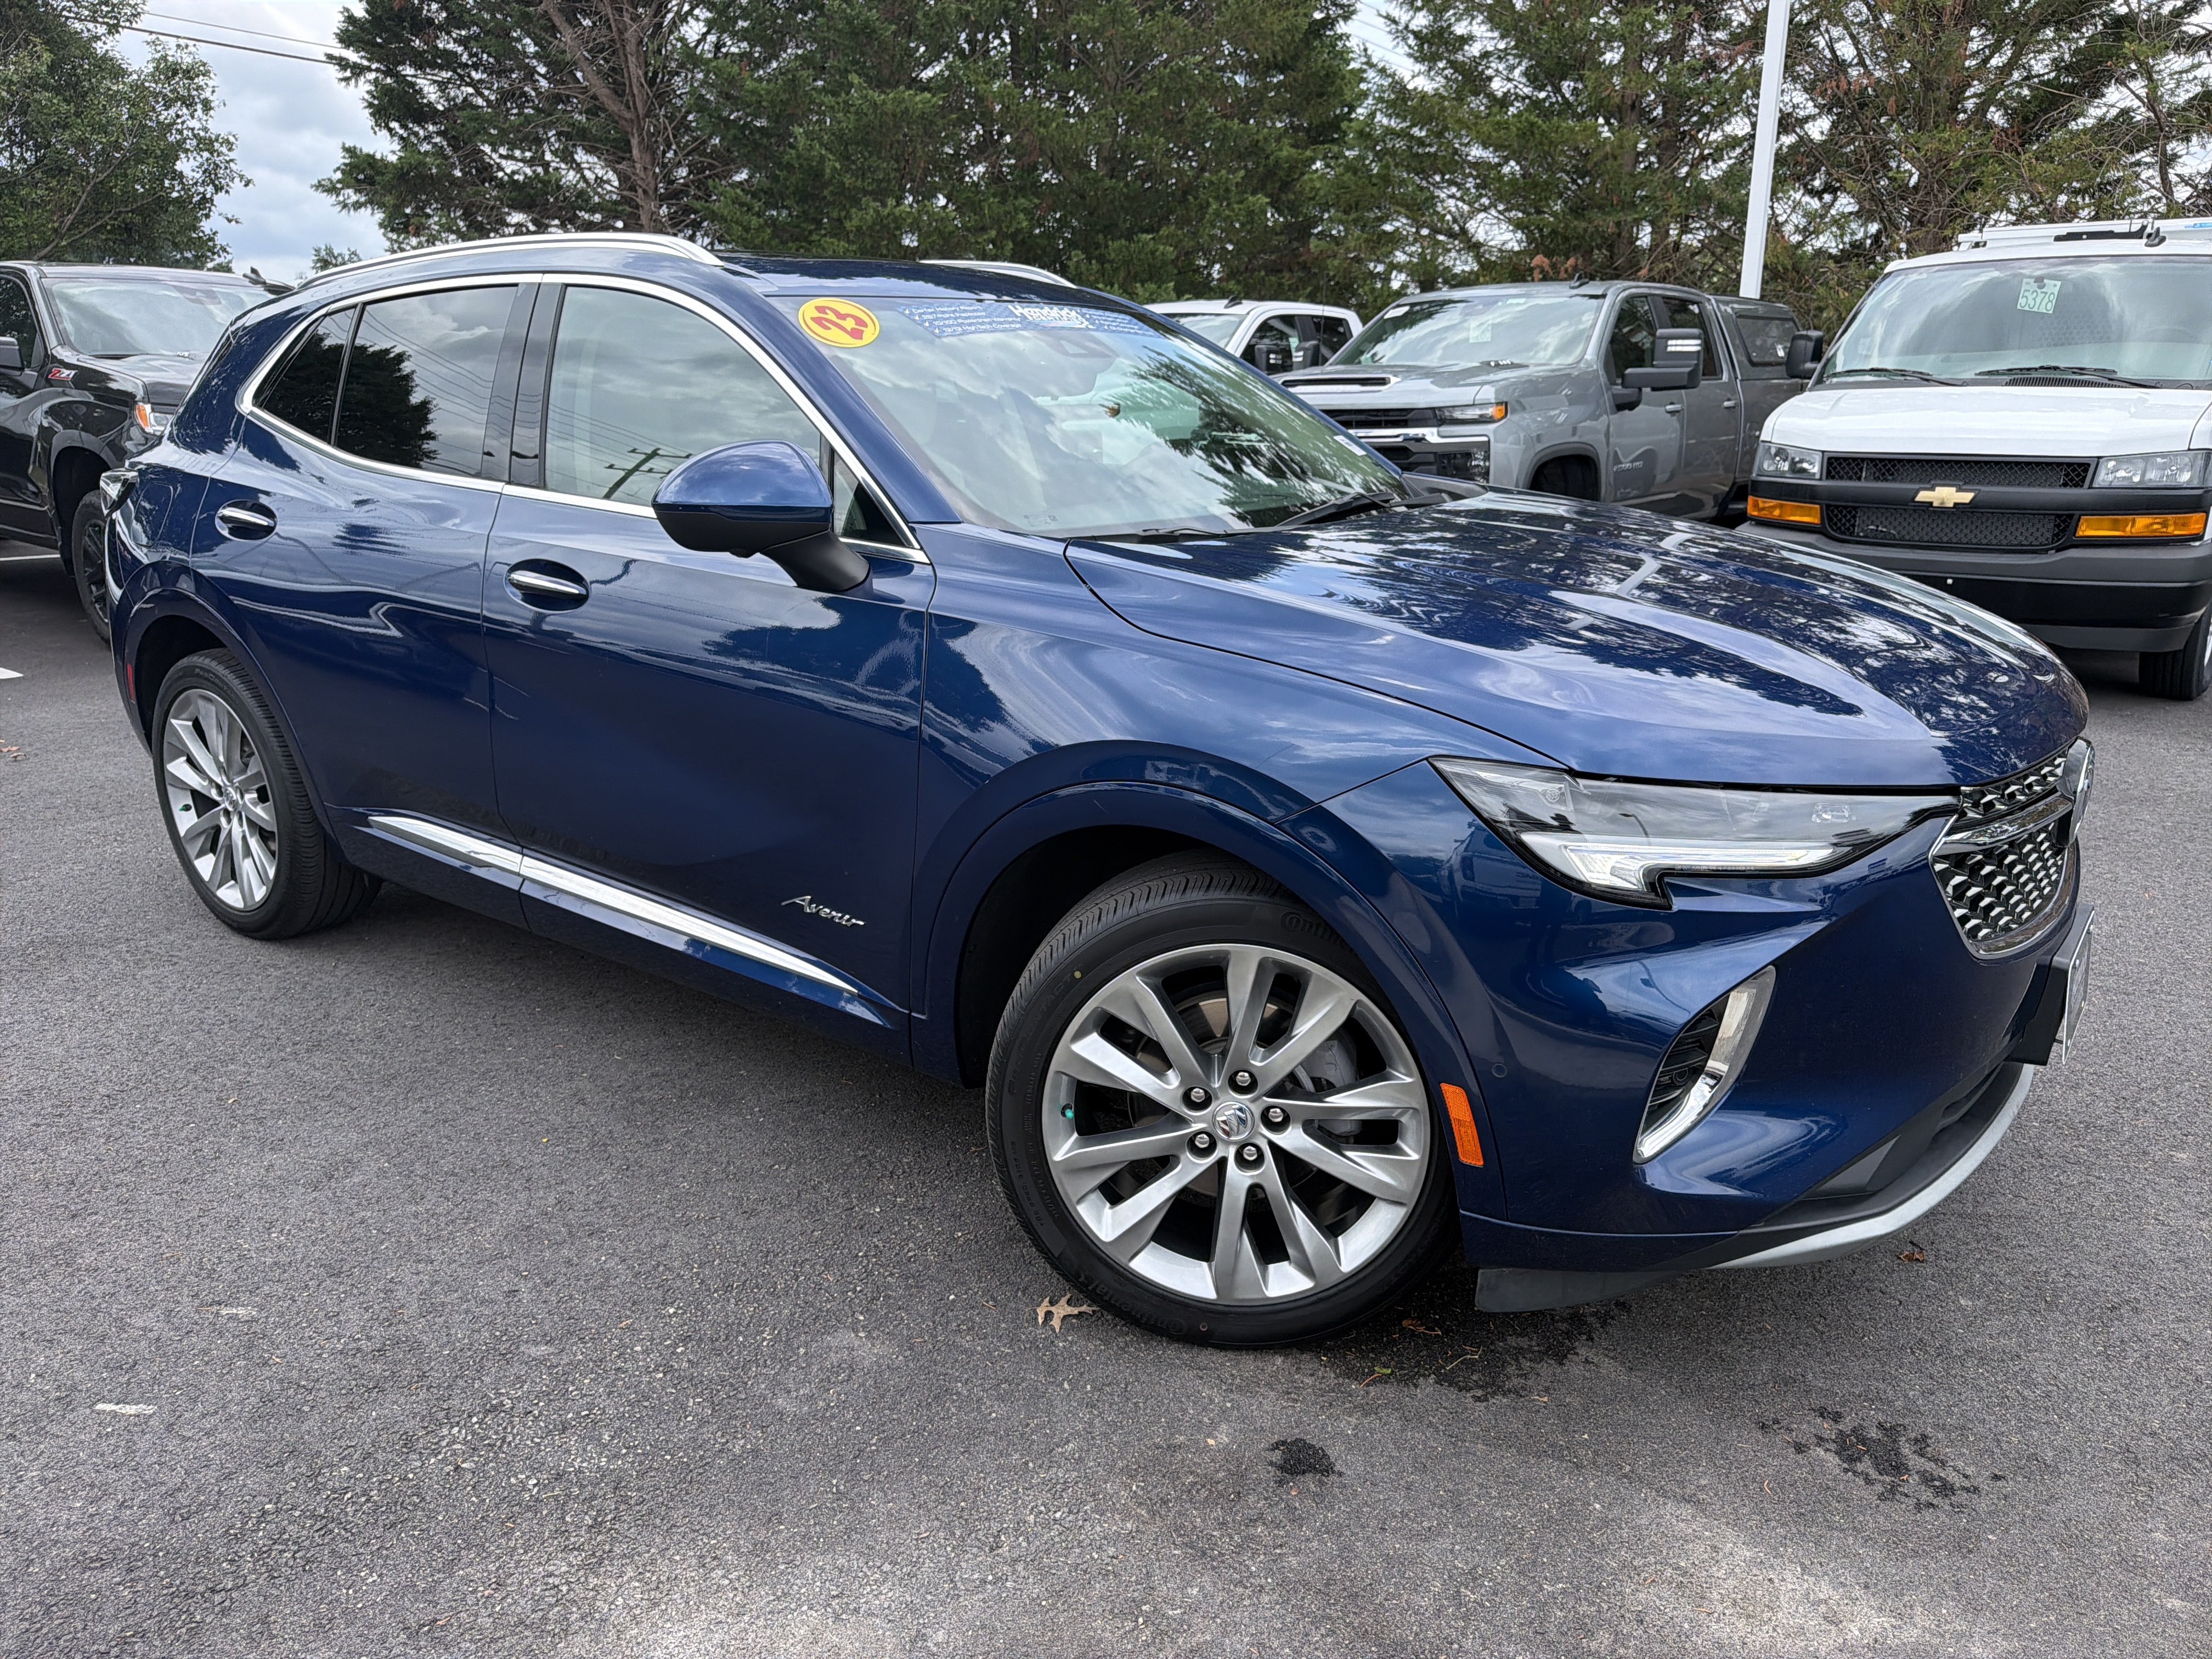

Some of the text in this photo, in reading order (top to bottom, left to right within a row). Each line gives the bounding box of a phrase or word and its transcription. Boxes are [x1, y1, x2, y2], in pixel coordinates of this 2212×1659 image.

[2019, 289, 2056, 312] 5378
[810, 306, 868, 340] 23
[1007, 304, 1084, 321] Hendrick
[48, 368, 78, 381] Z71
[781, 895, 866, 927] Avenir
